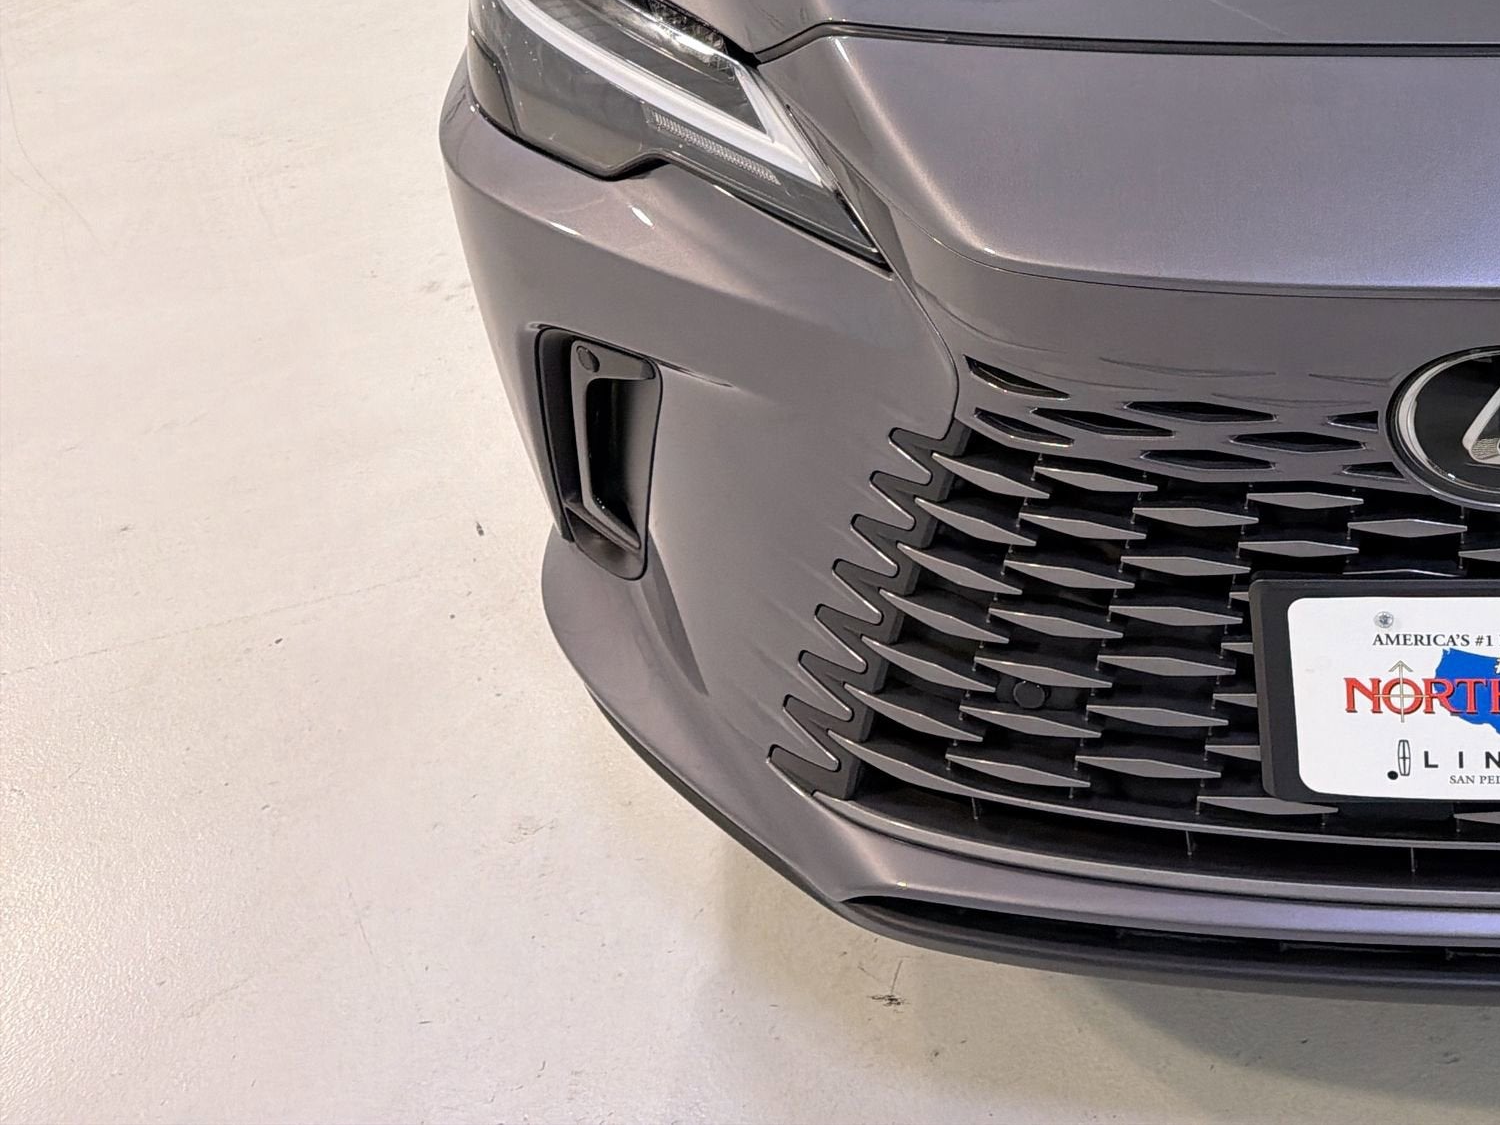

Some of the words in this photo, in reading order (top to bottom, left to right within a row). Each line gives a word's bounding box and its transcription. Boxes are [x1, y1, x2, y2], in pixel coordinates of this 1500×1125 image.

[1372, 633, 1470, 647] AMERICA'S
[1475, 634, 1494, 647] #1
[1449, 774, 1475, 785] SAN
